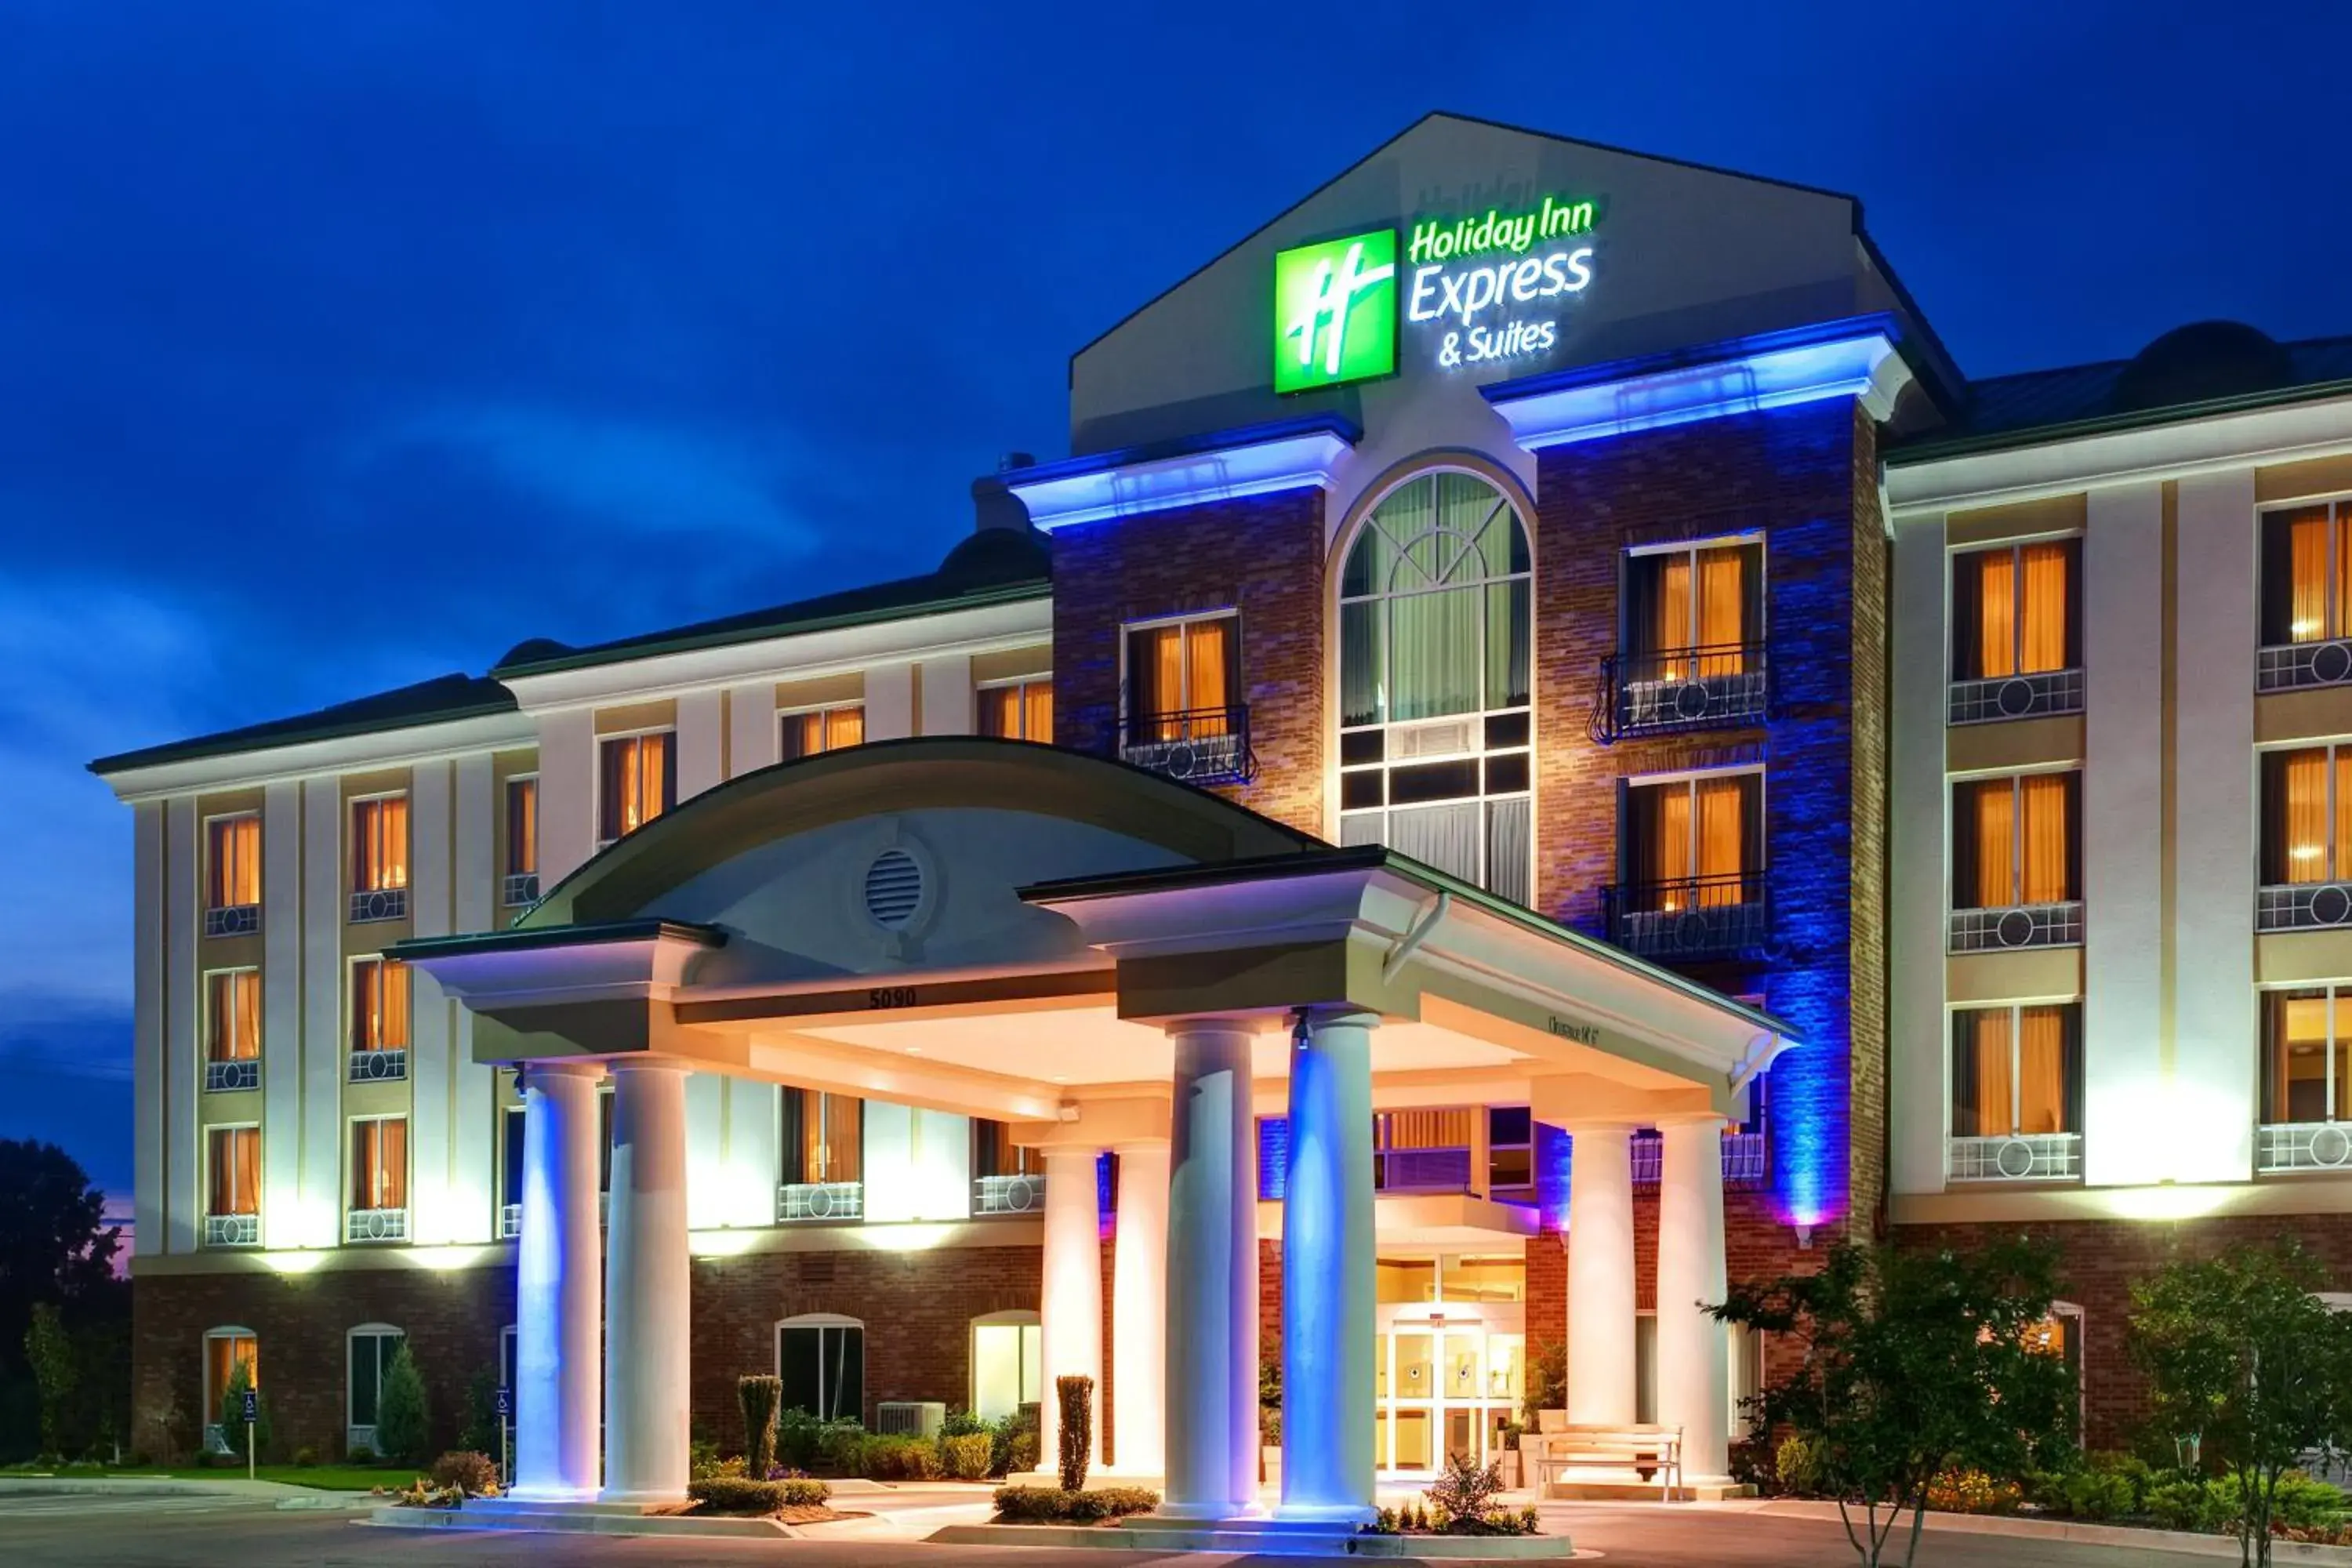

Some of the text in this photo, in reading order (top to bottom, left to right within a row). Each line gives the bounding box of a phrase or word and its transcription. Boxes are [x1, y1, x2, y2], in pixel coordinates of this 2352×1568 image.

[1409, 198, 1592, 263] Holiday Inn
[1409, 248, 1592, 325] Express
[1439, 320, 1555, 367] & Suites
[870, 987, 916, 1009] 5090
